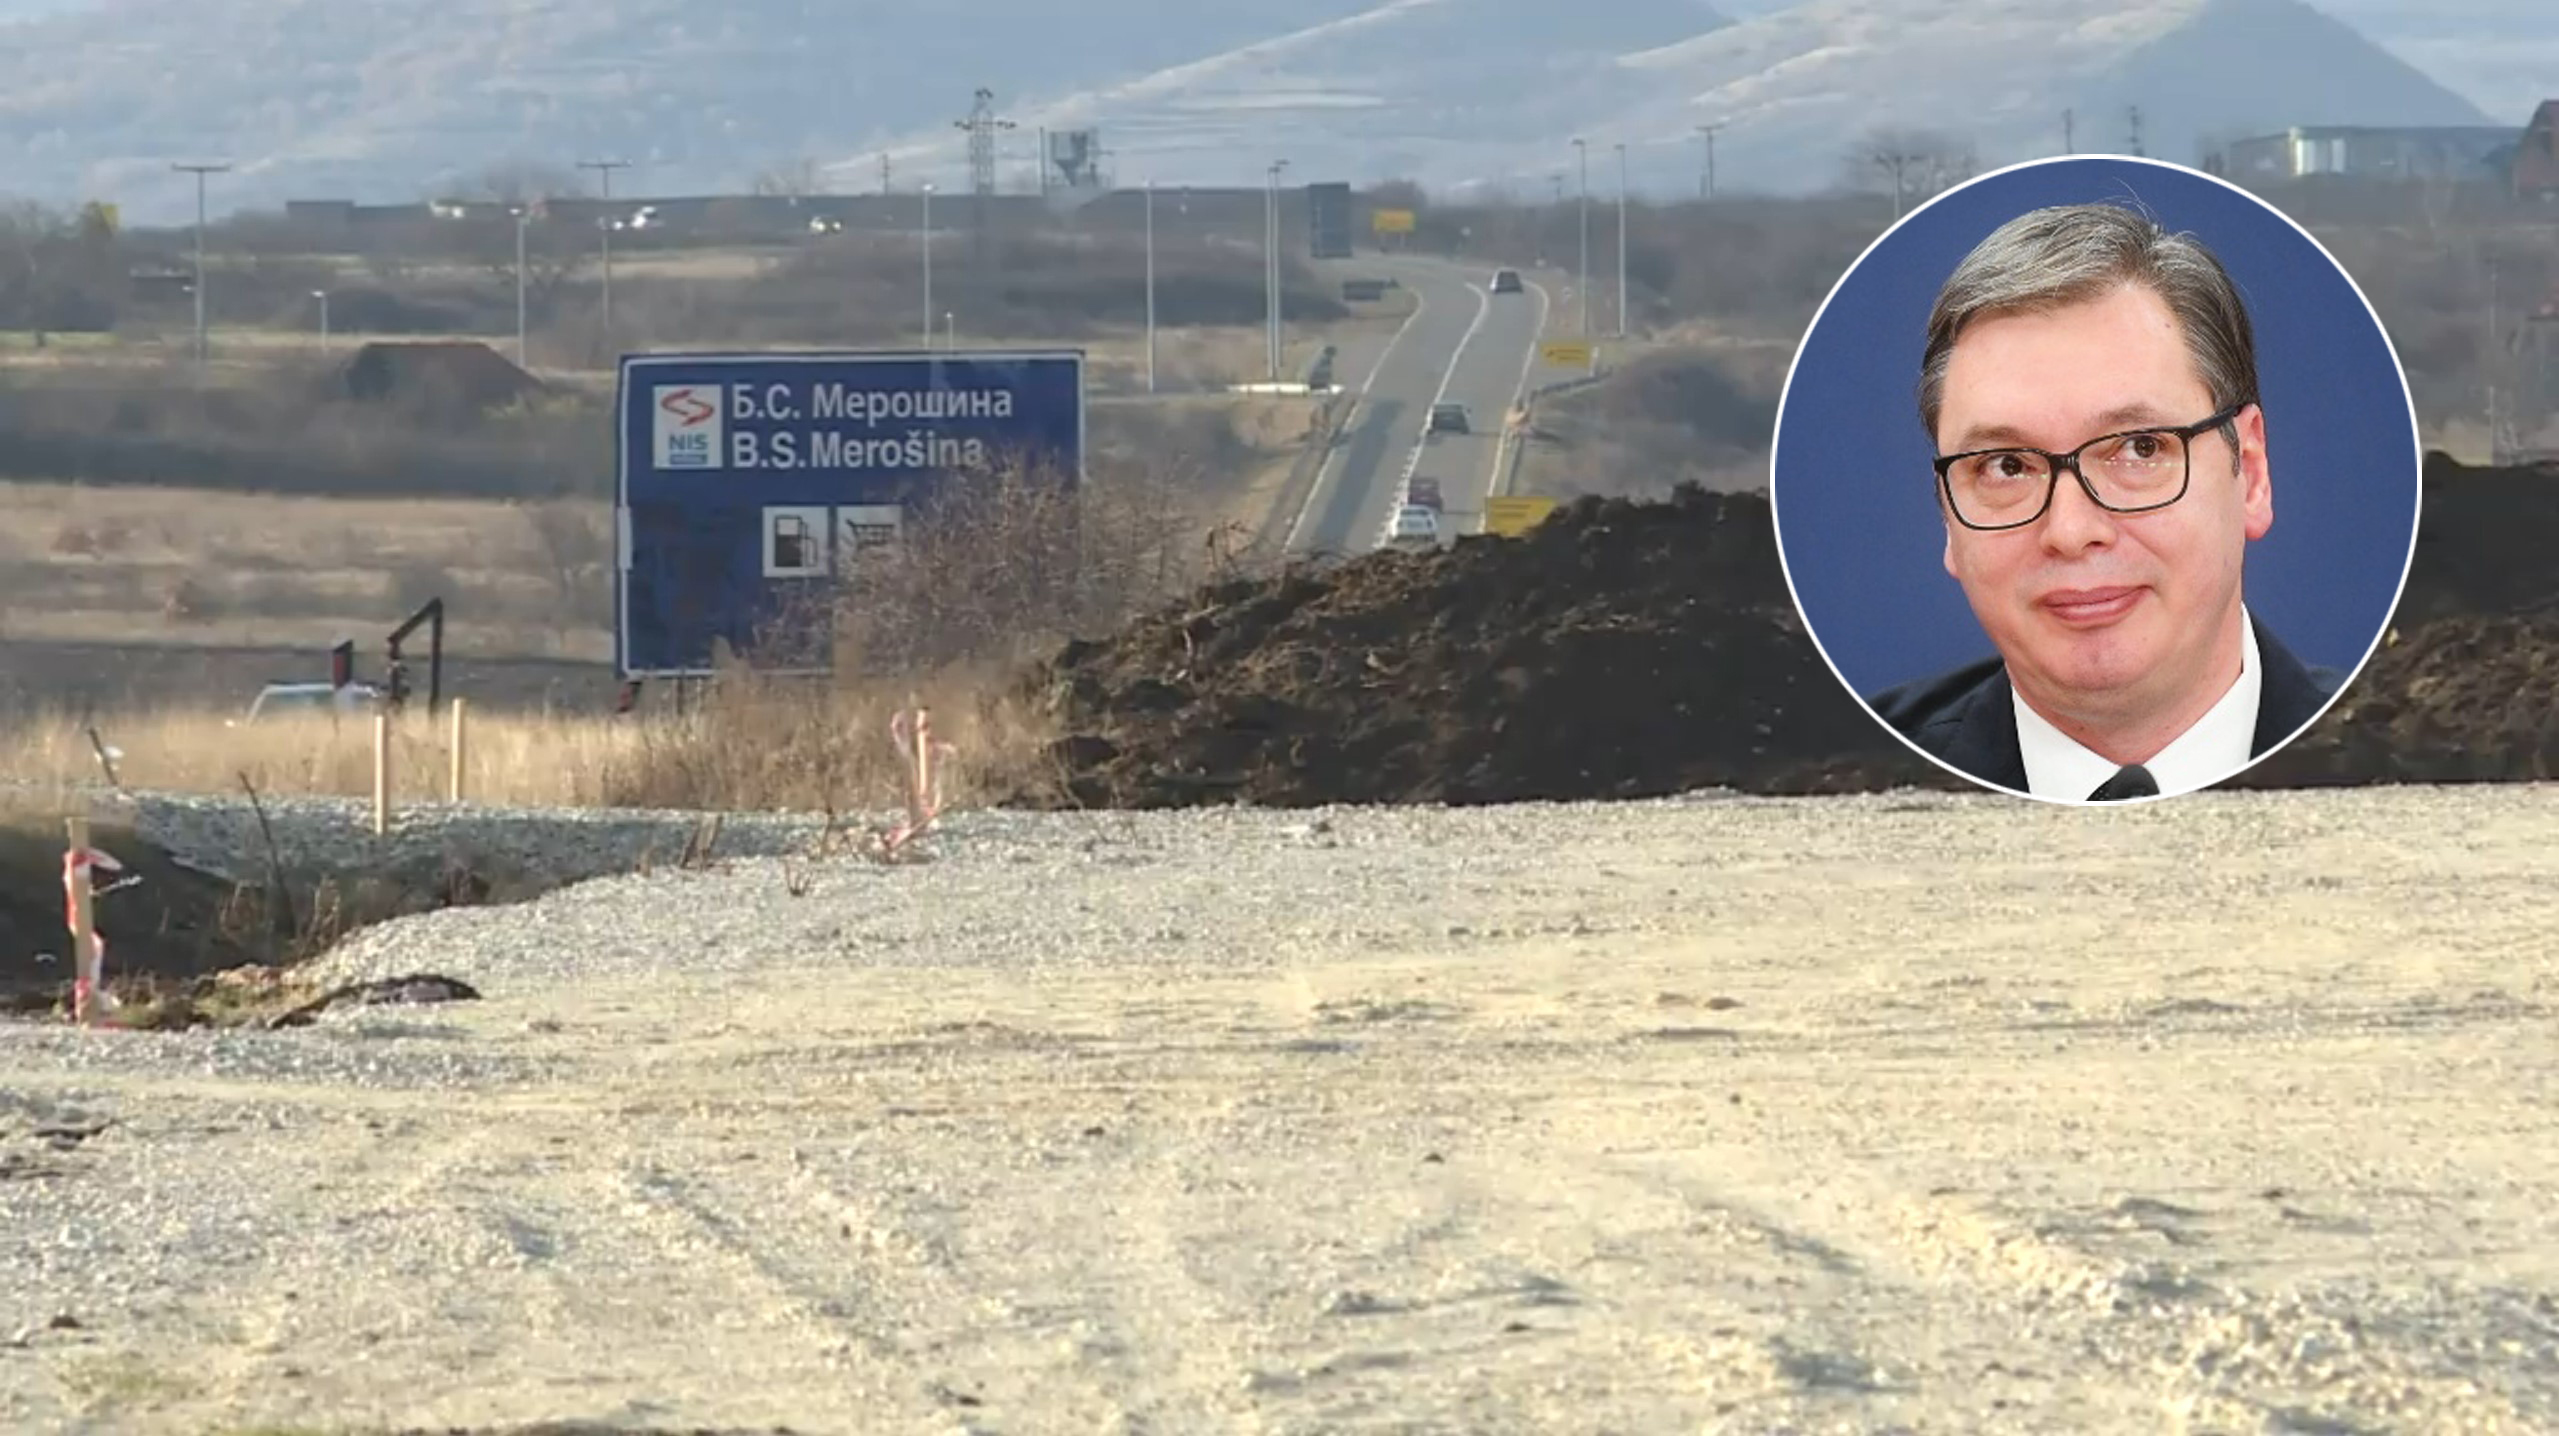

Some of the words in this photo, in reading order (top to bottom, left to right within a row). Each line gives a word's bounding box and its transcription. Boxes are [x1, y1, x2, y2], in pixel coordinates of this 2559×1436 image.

[732, 383, 801, 420] Б.С.
[812, 383, 1013, 428] Мерошина
[669, 433, 709, 450] NIS
